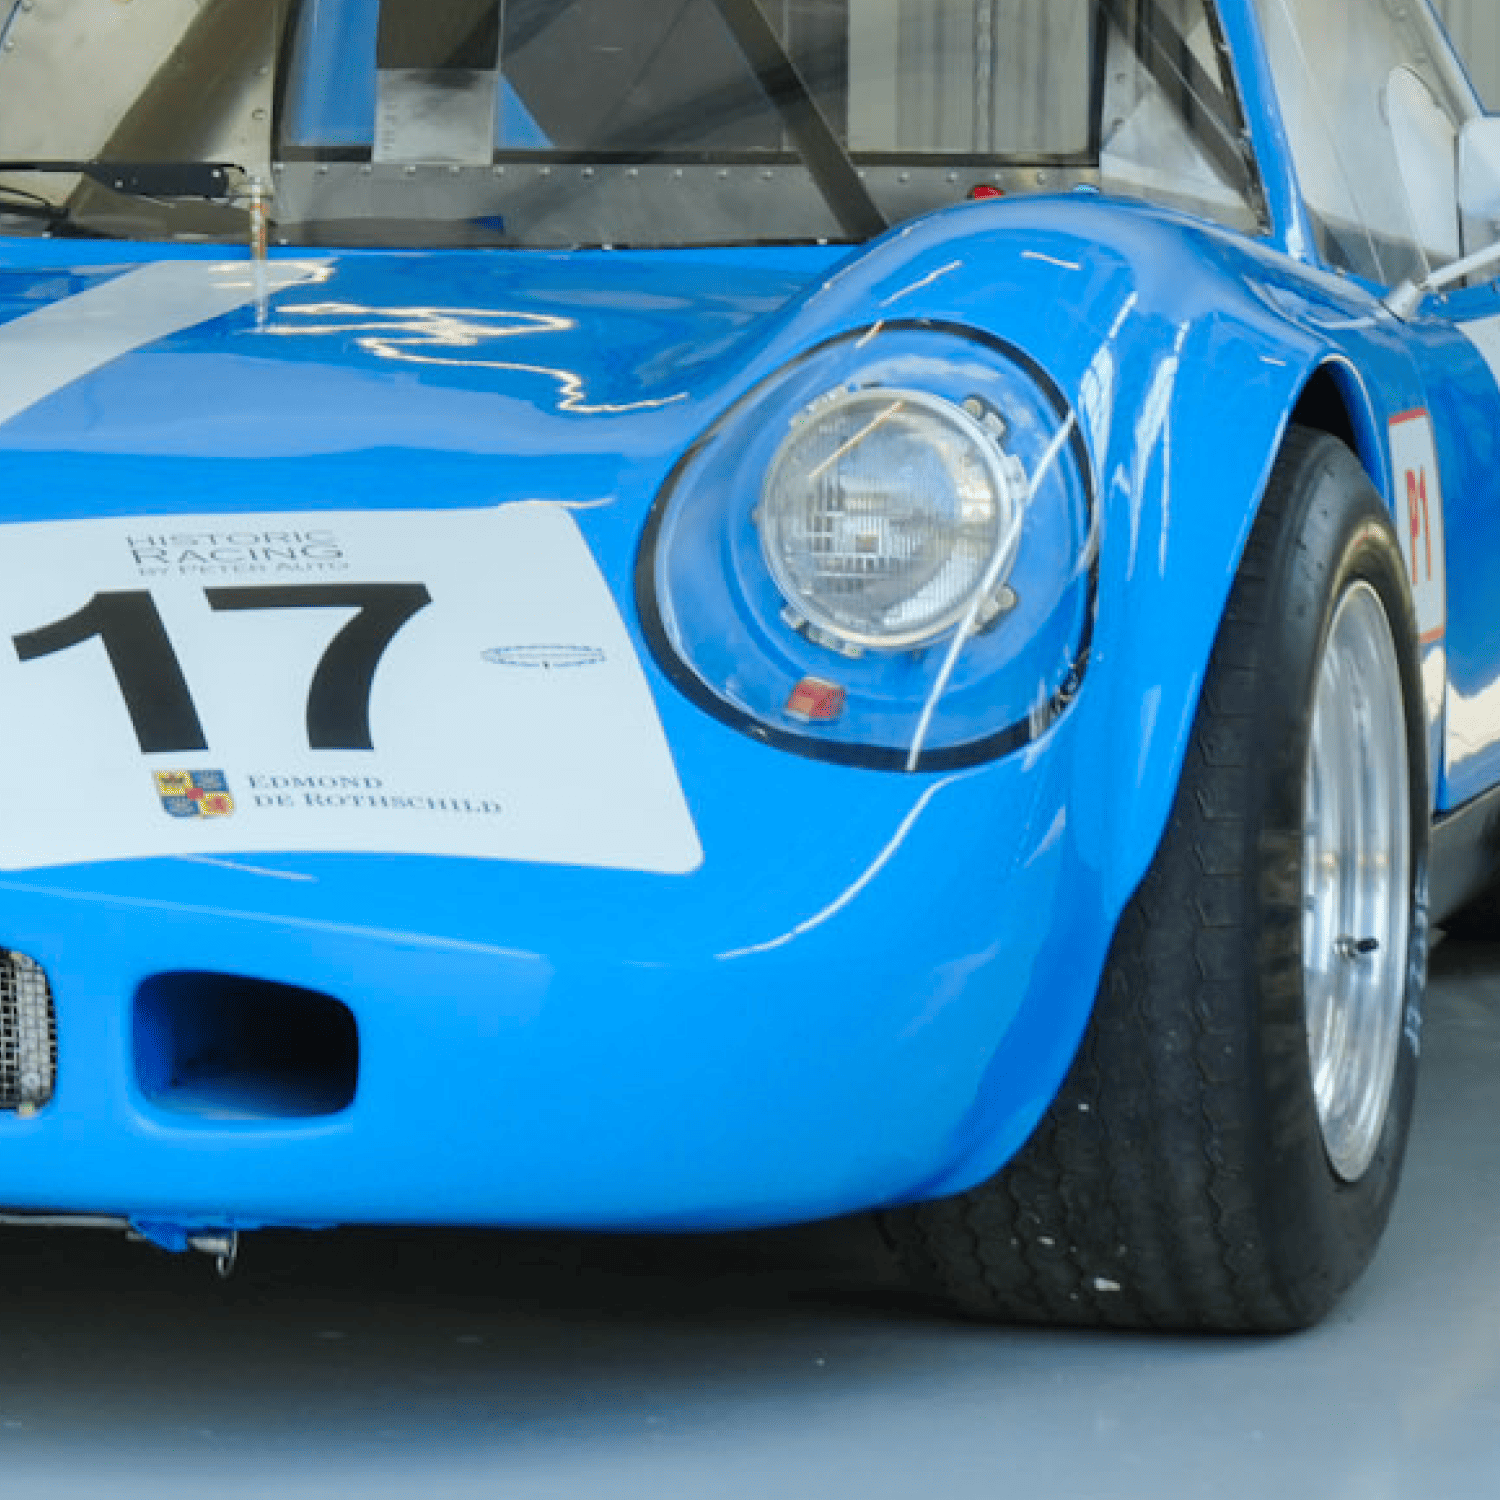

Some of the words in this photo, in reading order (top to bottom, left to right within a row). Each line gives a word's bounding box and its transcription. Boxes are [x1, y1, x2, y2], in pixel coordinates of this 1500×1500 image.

[125, 530, 334, 546] HISTORIC
[131, 544, 344, 563] RACING
[12, 582, 433, 753] 17
[247, 774, 384, 790] EDMOND
[254, 794, 296, 808] DE
[303, 792, 503, 815] ROTHSCHILD
